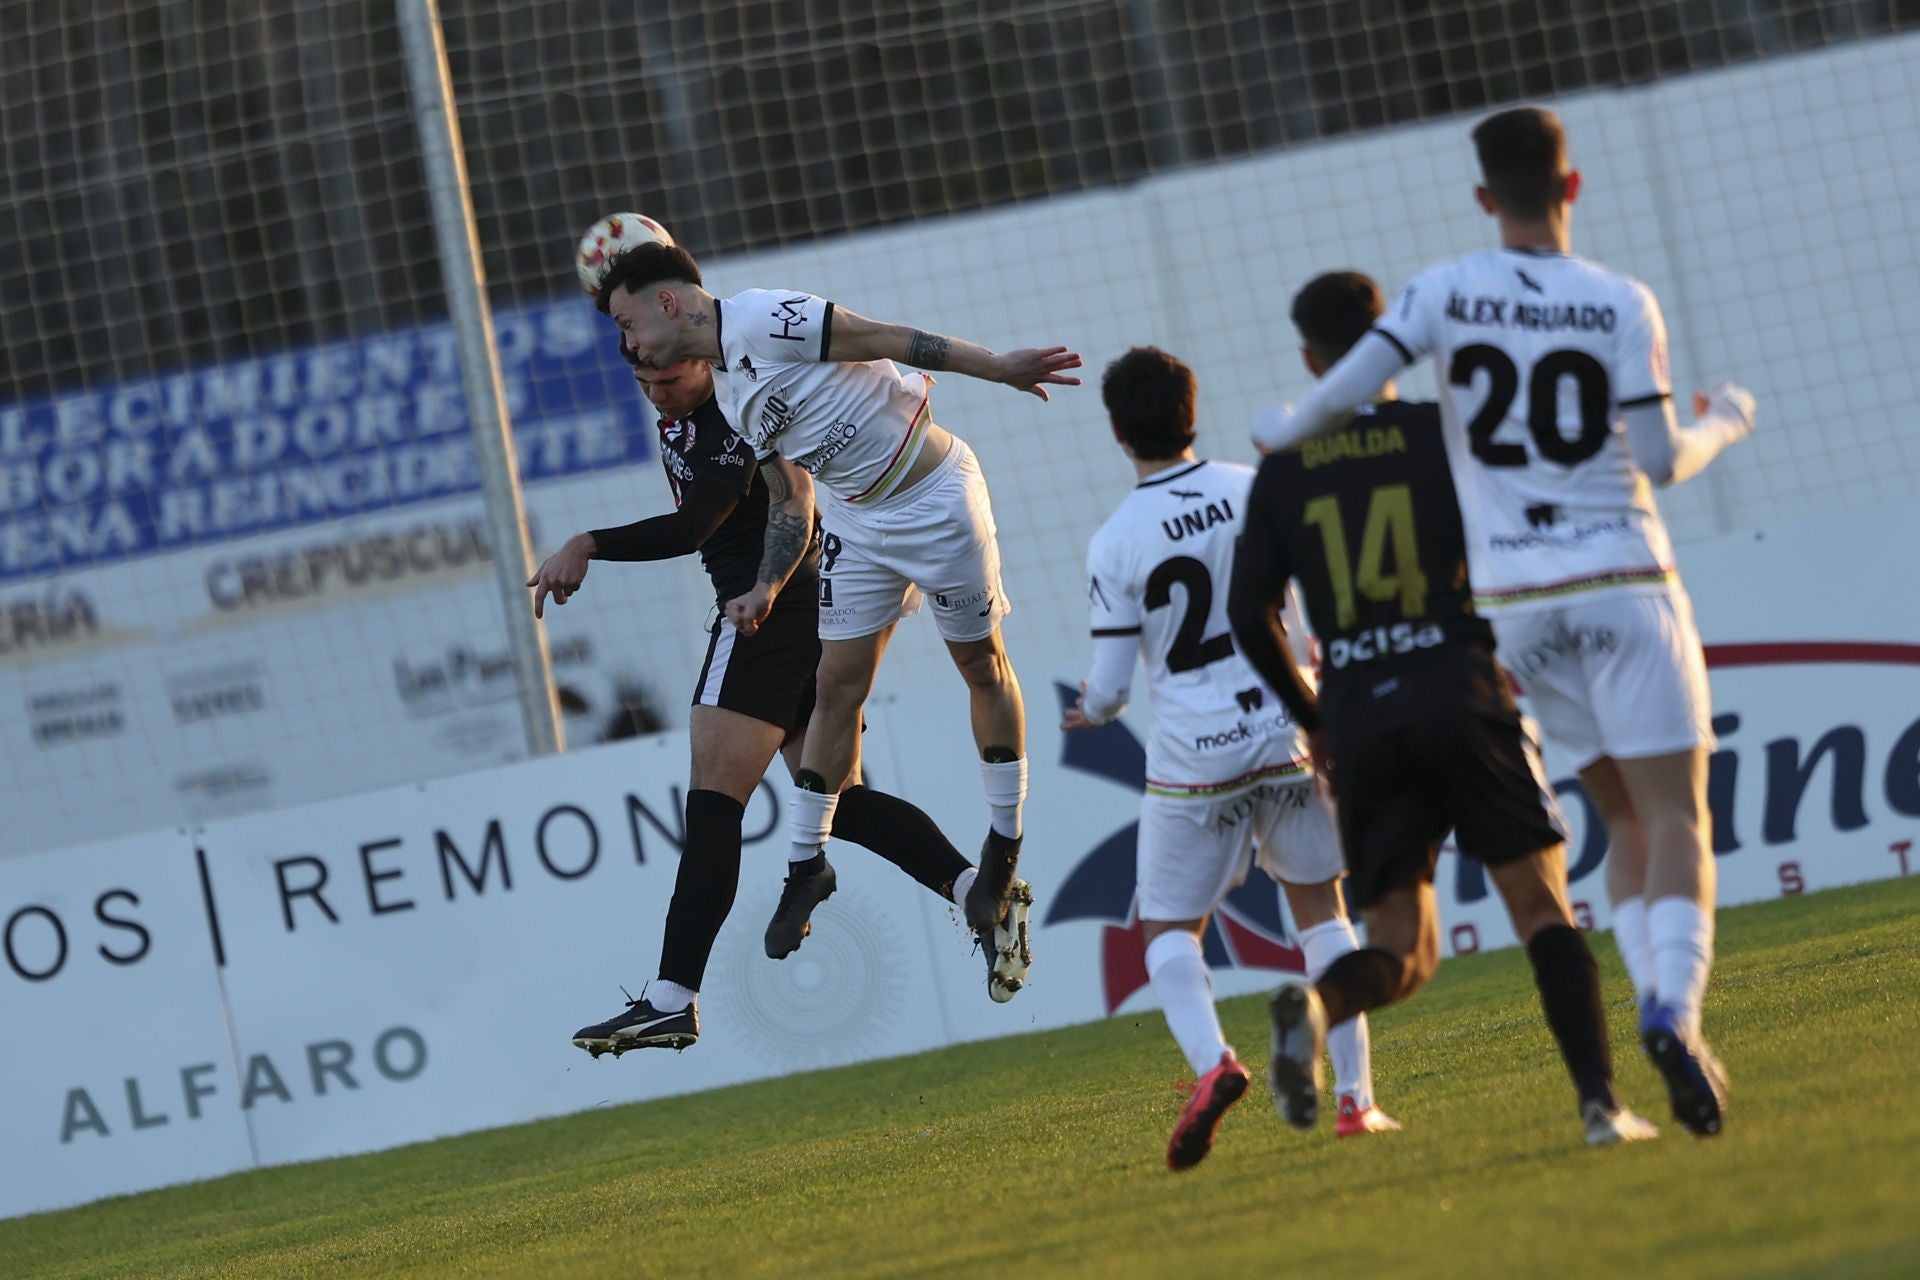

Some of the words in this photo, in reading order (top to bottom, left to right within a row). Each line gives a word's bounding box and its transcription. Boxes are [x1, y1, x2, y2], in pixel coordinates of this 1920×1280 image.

[1450, 343, 1609, 468] 20
[204, 512, 542, 609] CREPUSCUL
[1162, 499, 1234, 541] UNAI
[1304, 482, 1430, 632] 14
[1144, 556, 1236, 673] 2
[272, 755, 876, 935] REMOND
[59, 1025, 429, 1145] ALFARO
